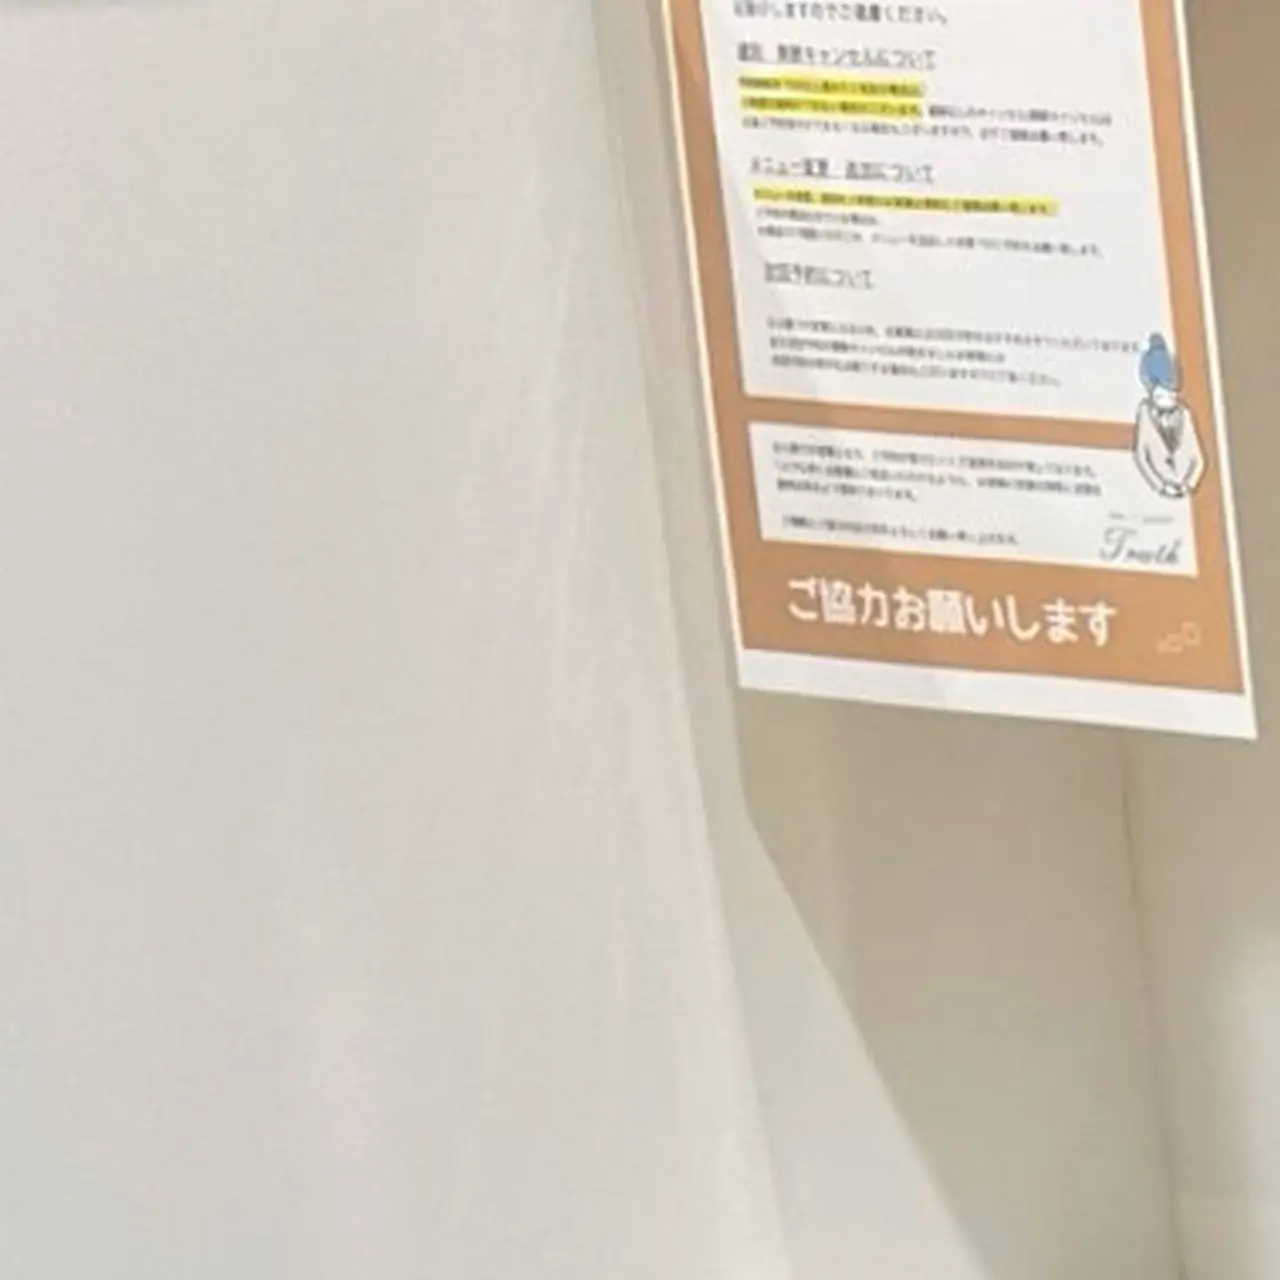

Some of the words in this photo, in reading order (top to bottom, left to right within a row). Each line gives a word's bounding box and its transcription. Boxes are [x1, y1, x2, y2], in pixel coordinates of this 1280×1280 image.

[787, 576, 1118, 647] ご協力お願いします
